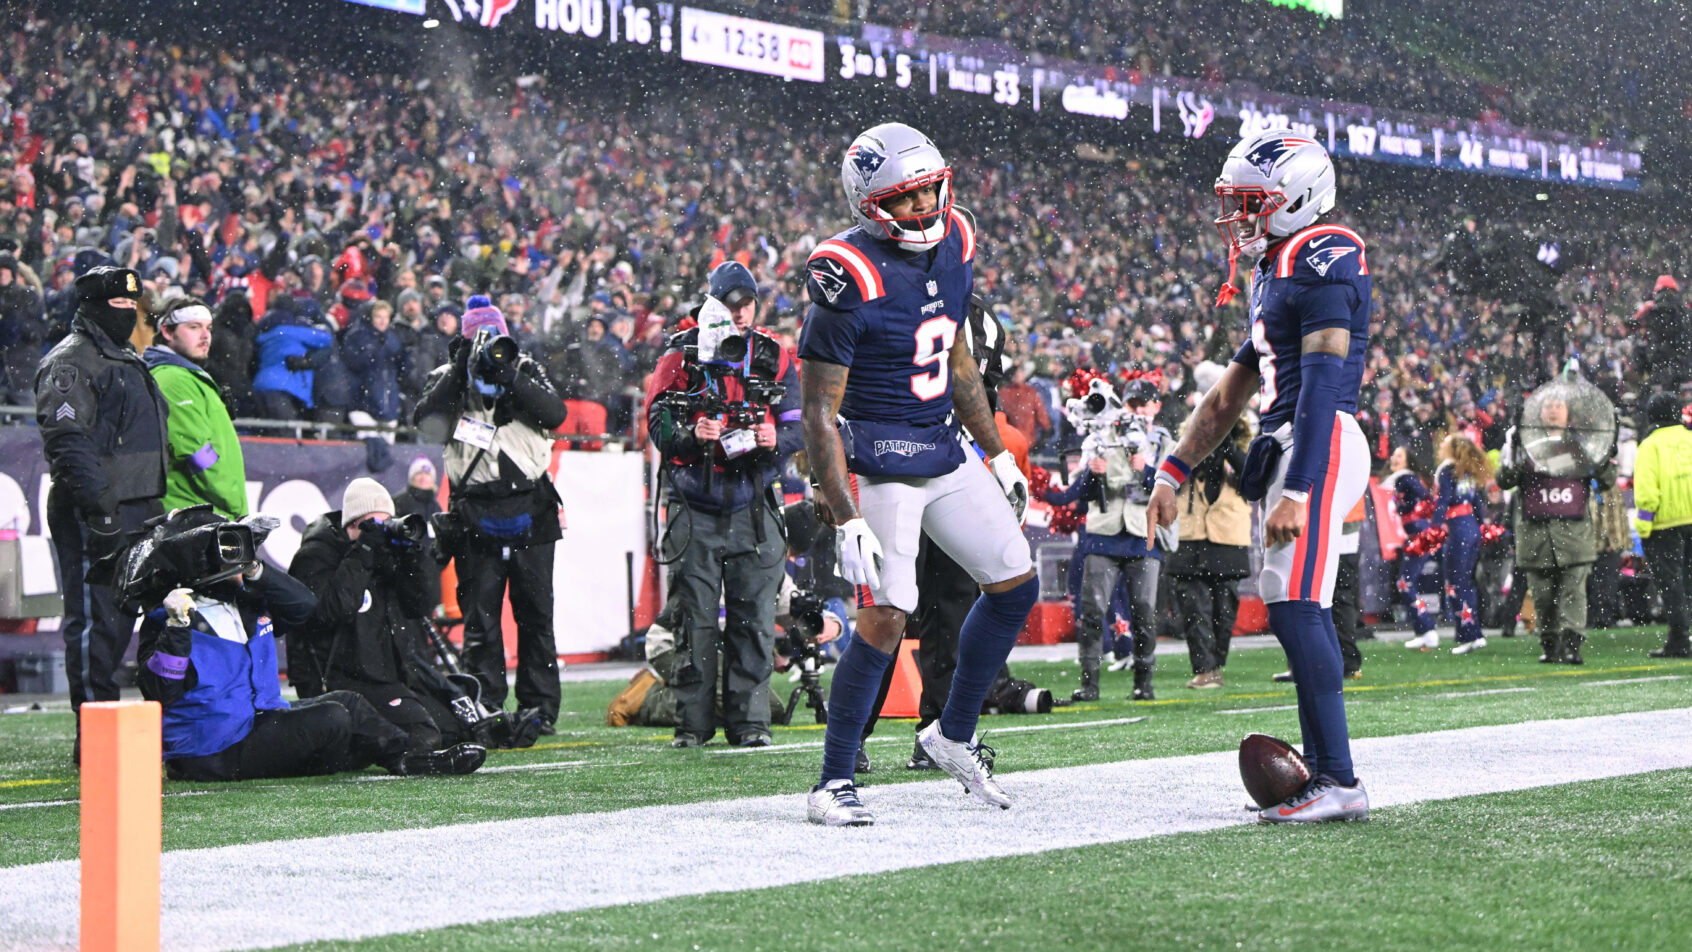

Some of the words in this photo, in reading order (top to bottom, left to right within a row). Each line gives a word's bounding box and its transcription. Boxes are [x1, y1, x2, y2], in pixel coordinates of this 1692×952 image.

[535, 0, 603, 38] HOU
[623, 5, 652, 45] 16
[724, 26, 780, 62] 12:58
[896, 54, 912, 88] 5
[994, 70, 1020, 105] 33
[1347, 124, 1377, 156] 167
[1459, 140, 1483, 169] 44
[1559, 152, 1578, 181] 14
[911, 314, 958, 402] 9
[1539, 487, 1573, 504] 166
